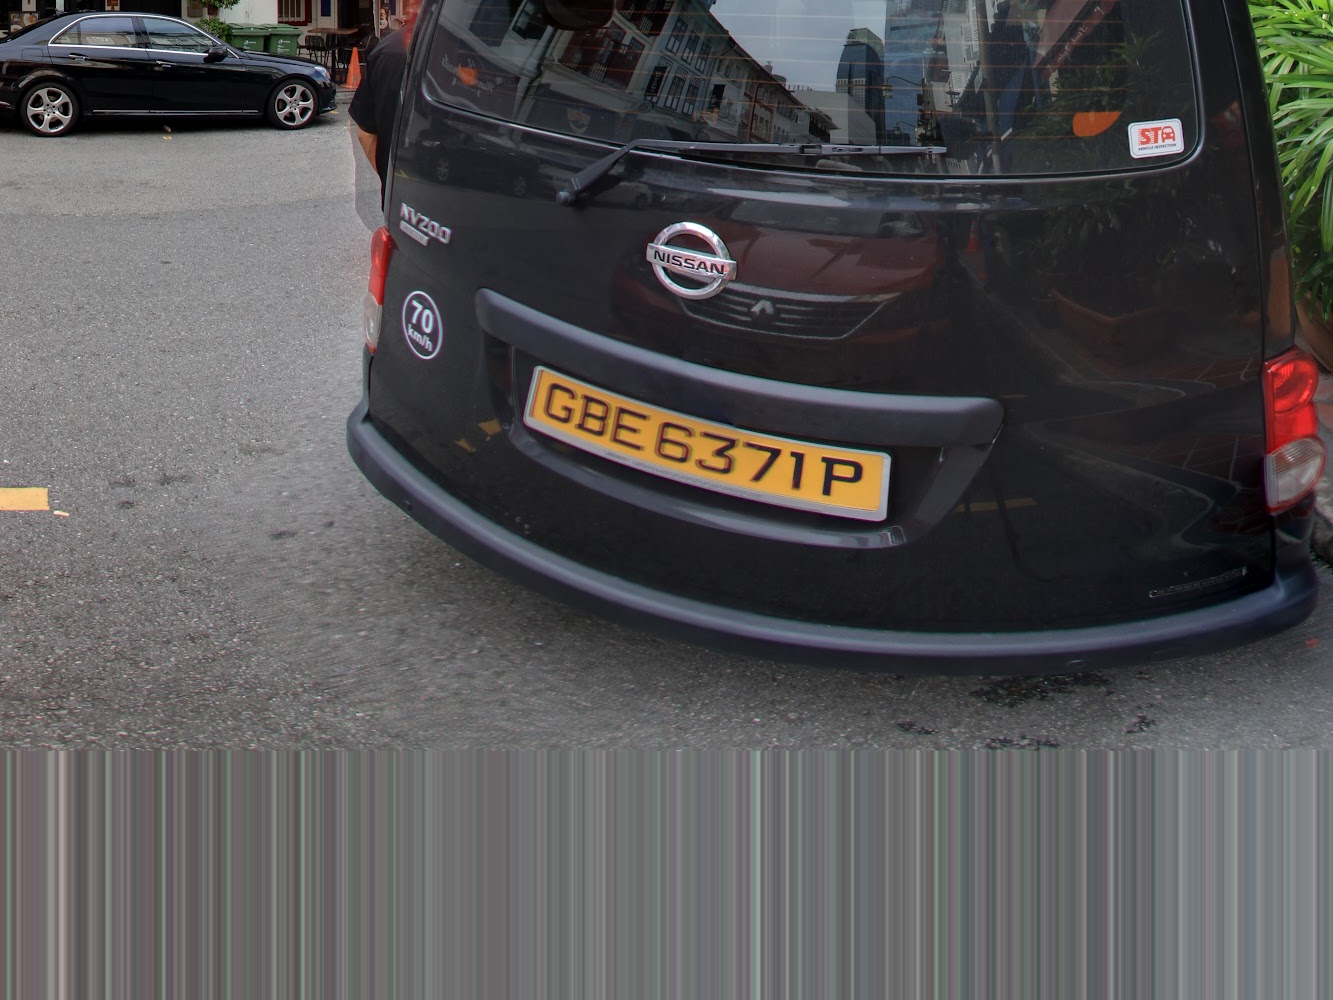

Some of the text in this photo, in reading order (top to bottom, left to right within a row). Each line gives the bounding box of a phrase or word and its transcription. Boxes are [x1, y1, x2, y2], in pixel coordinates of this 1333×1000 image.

[1138, 125, 1176, 146] STA
[400, 202, 452, 245] NV200
[653, 248, 726, 275] NISSAN
[412, 300, 434, 334] 70
[408, 323, 433, 352] km/h
